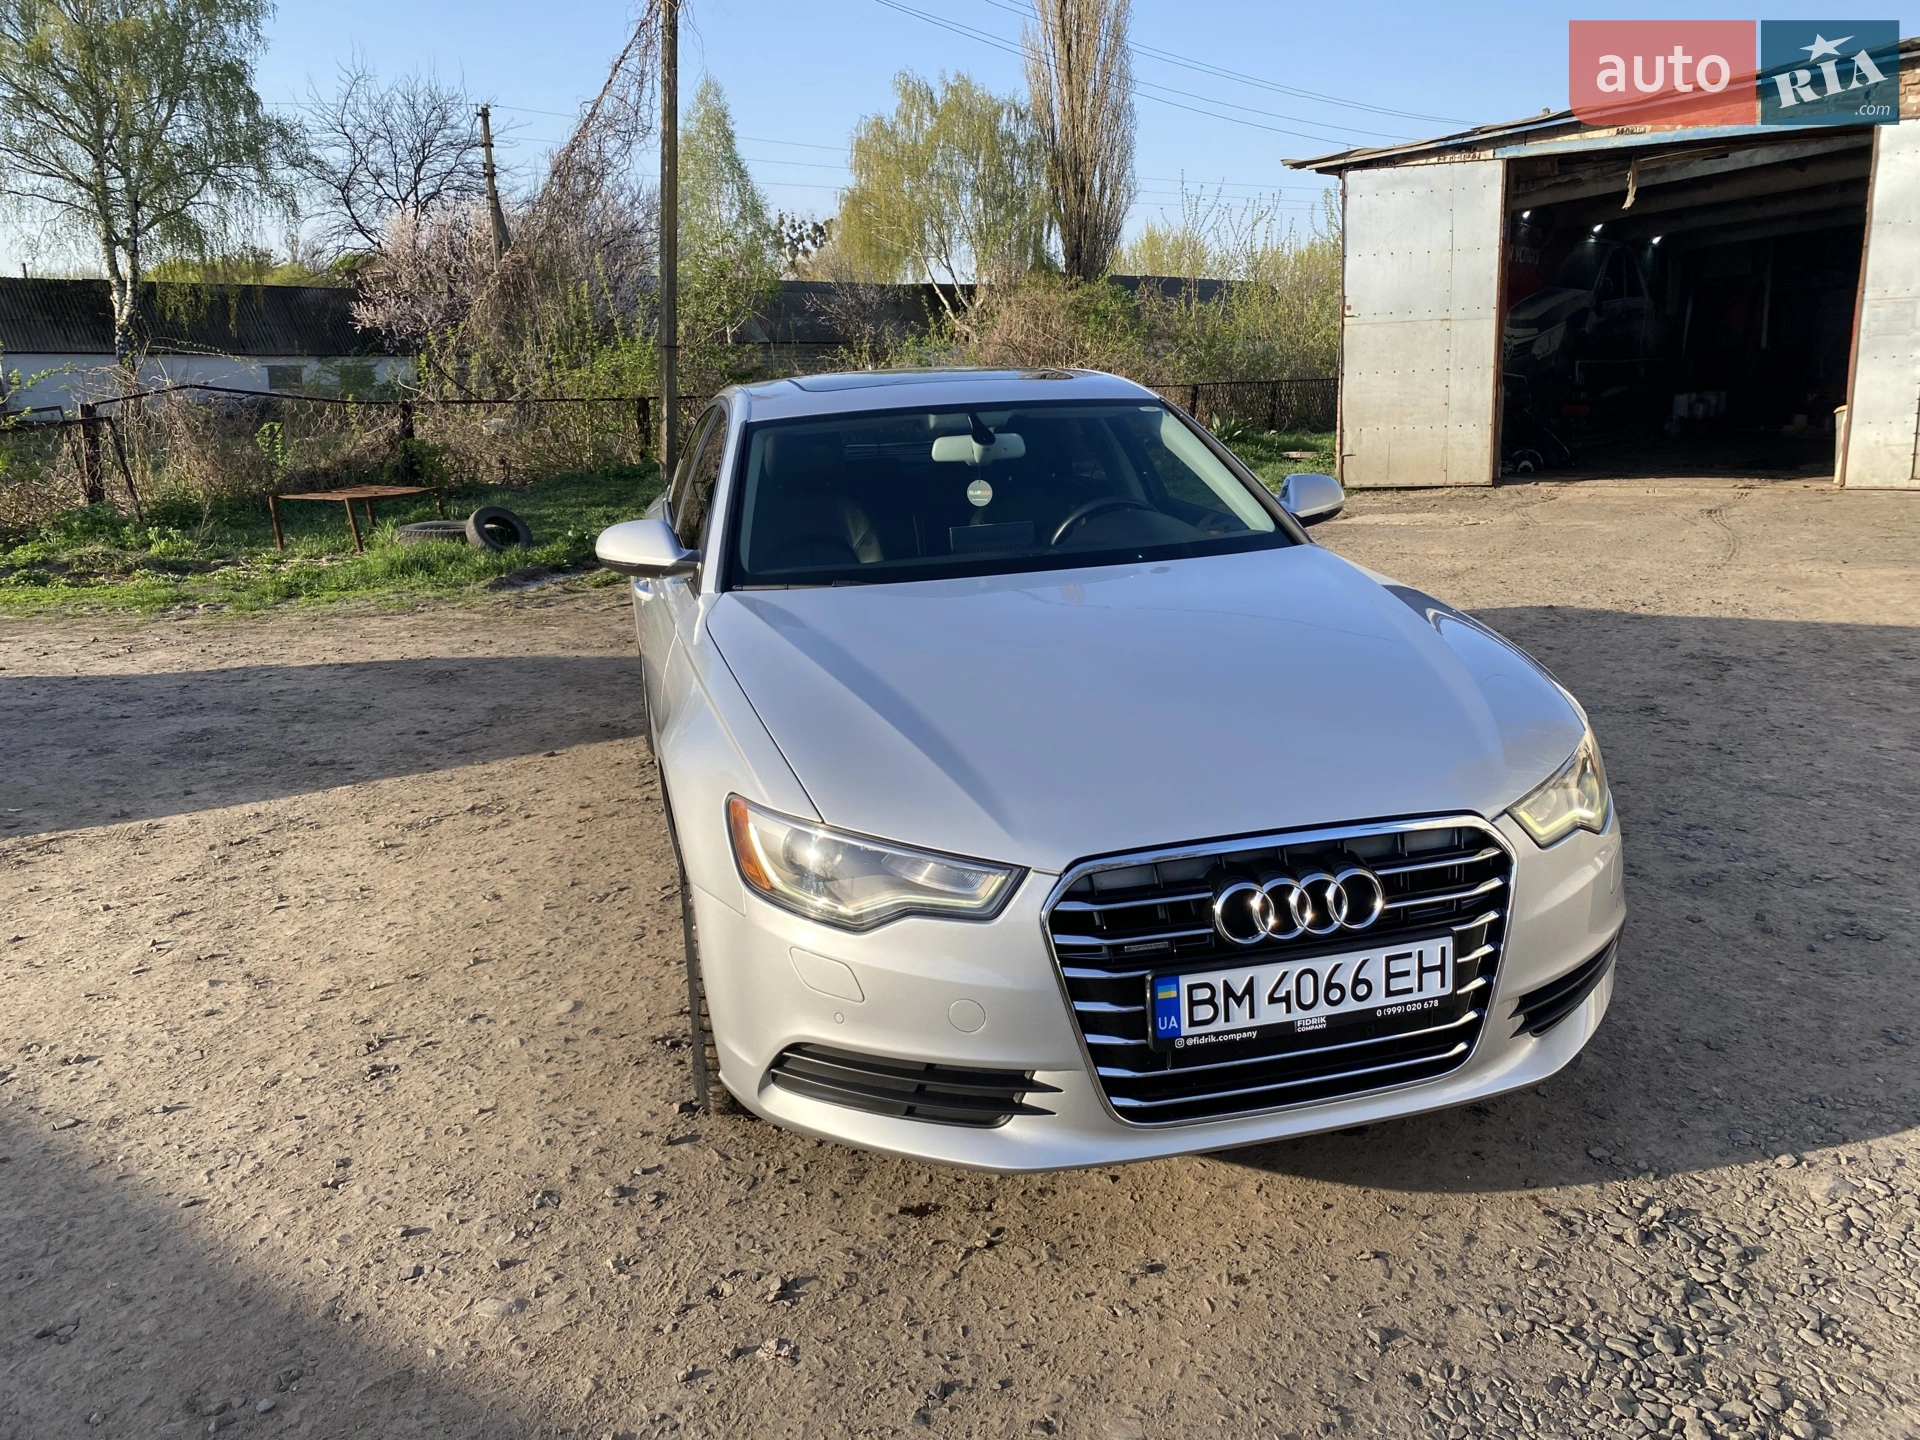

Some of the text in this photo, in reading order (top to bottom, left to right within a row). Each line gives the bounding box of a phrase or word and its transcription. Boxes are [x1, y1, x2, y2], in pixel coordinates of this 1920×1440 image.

[1185, 946, 1447, 1029] BM 4066 EH
[1376, 999, 1439, 1017] 0 (999) 020 678
[1157, 1016, 1179, 1031] UA
[1297, 1016, 1327, 1027] FIDRIK
[1297, 1023, 1327, 1033] COMPANY
[1186, 1029, 1258, 1046] @fidrik.company
